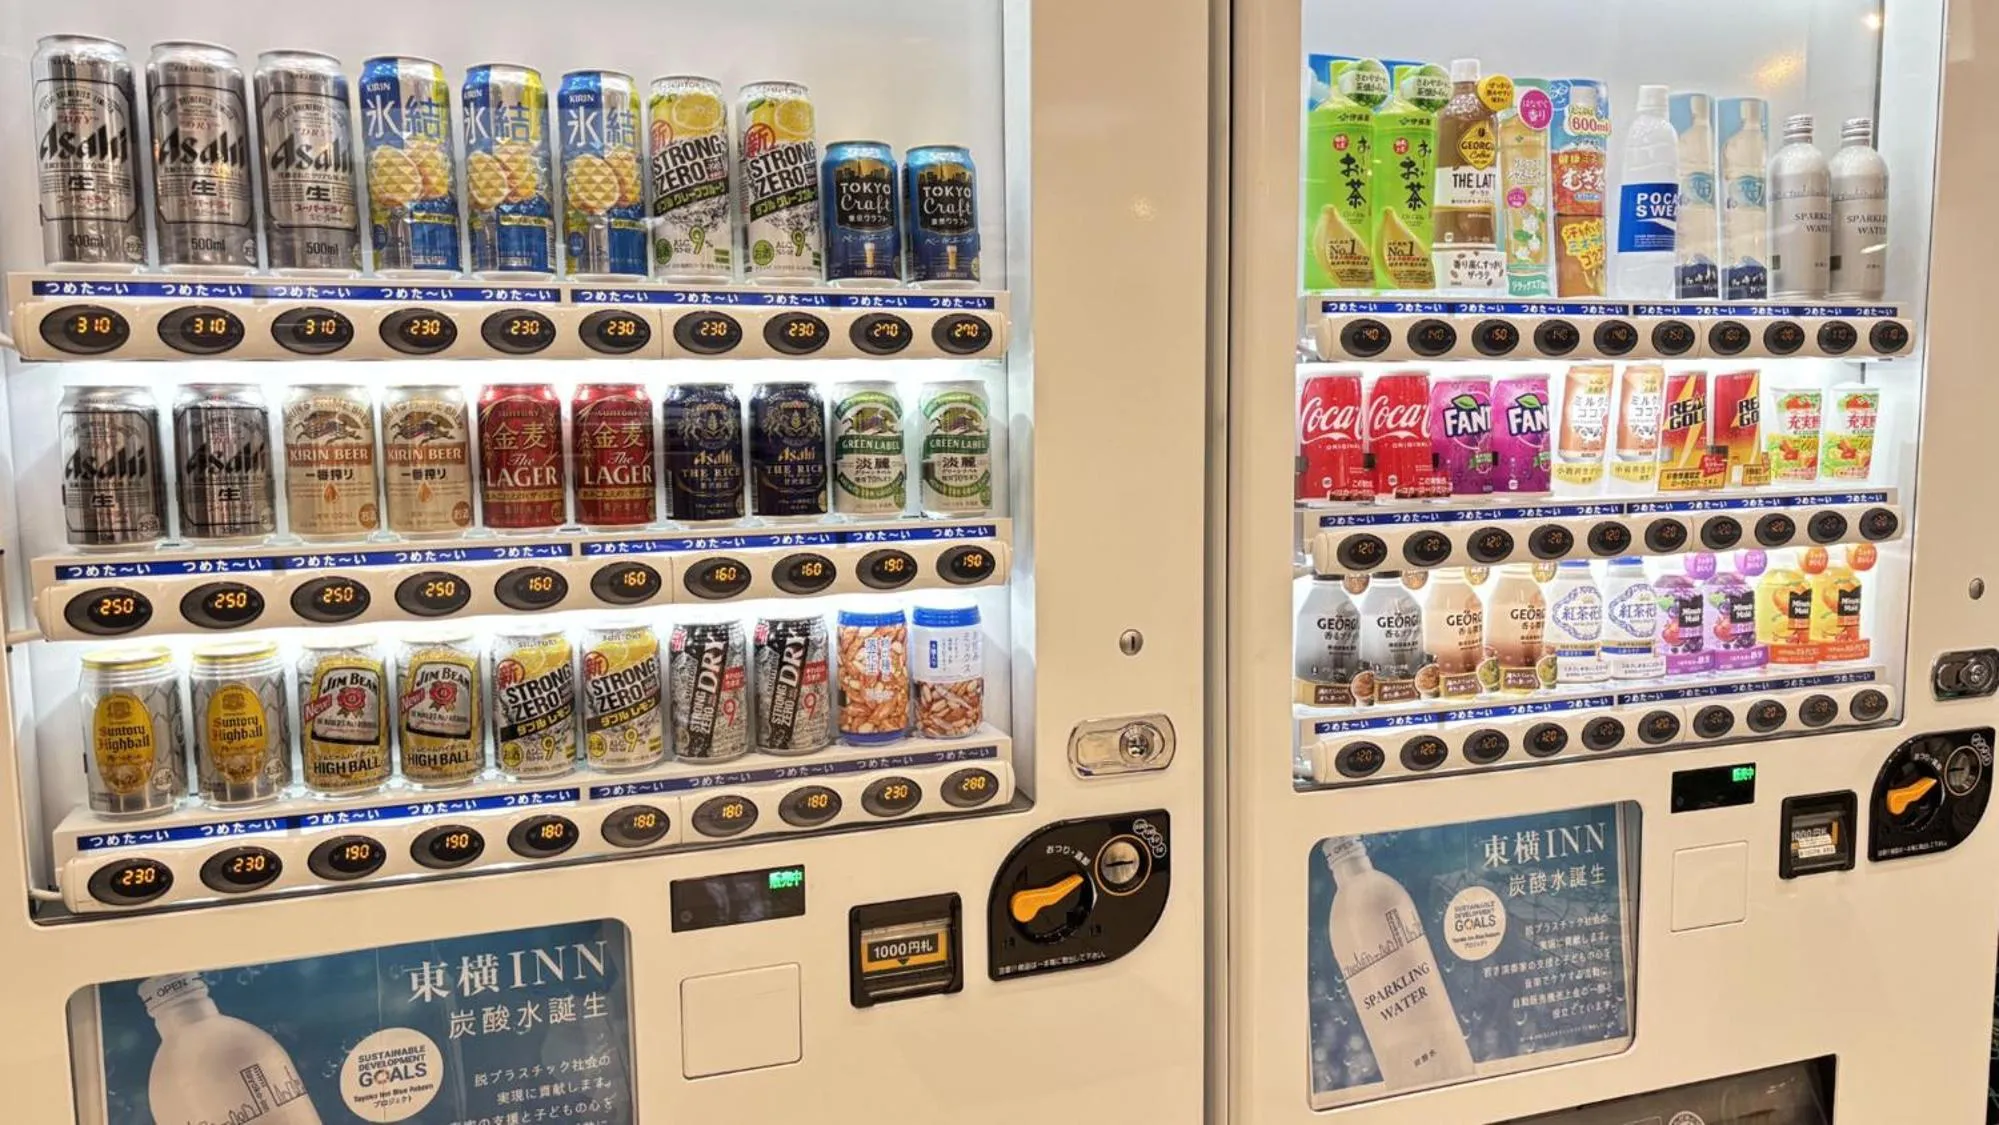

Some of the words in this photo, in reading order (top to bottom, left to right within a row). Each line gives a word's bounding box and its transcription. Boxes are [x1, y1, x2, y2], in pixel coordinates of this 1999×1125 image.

[366, 83, 391, 92] KIRIN
[569, 94, 595, 103] KIRIN
[366, 94, 441, 144] 氷結
[464, 101, 530, 145] 氷結
[1572, 117, 1610, 132] 600ml
[39, 122, 128, 164] Asahi
[159, 128, 244, 169] Asahi
[653, 135, 722, 176] STRONG
[750, 141, 816, 179] STRONG
[68, 175, 95, 191] 生
[655, 160, 706, 195] ZERO
[755, 166, 805, 198] ZERO
[1339, 152, 1367, 209] お茶
[1400, 157, 1427, 211] お茶
[1452, 173, 1474, 189] THE
[191, 179, 217, 196] 生
[306, 185, 331, 201] 生
[840, 182, 891, 194] TOKYO
[923, 186, 971, 198] TOKYO
[841, 194, 892, 213] Craft
[923, 199, 972, 218] Craft
[68, 234, 104, 248] 500ml
[191, 238, 225, 251] 500ml
[306, 241, 339, 255] 500ml
[1388, 240, 1415, 258] No.1
[76, 317, 110, 334] 310
[194, 317, 226, 334] 310
[410, 319, 440, 336] 230
[607, 321, 635, 336] 230
[954, 323, 978, 337] 270
[492, 421, 548, 450] 金麦
[592, 421, 645, 449] 金麦
[65, 444, 145, 480] Asahi
[186, 441, 266, 477] Asahi
[290, 447, 333, 461] KIRIN
[336, 447, 368, 460] BEER
[388, 448, 424, 461] KIRIN
[429, 446, 462, 460] BEER
[507, 452, 535, 466] The
[608, 451, 634, 465] The
[693, 450, 734, 465] Asahi
[778, 446, 816, 463] Asahi
[855, 456, 890, 468] 淡麗
[942, 456, 975, 468] 淡麗
[305, 469, 355, 481] 一番搾り
[401, 468, 447, 480] 一番搾り
[486, 466, 558, 488] LAGER
[584, 465, 653, 485] LAGER
[682, 468, 709, 478] THE
[767, 465, 792, 474] THE
[91, 494, 115, 508] 生
[218, 487, 241, 501] 生
[801, 562, 822, 576] 160
[962, 554, 982, 568] 190
[528, 577, 552, 591] 160
[323, 588, 353, 603] 250
[100, 598, 134, 615] 250
[698, 632, 725, 693] DRY
[780, 628, 806, 687] DRY
[323, 675, 347, 693] JIM
[416, 670, 439, 687] JIM
[506, 663, 571, 704] STRONG
[591, 657, 655, 696] STRONG
[512, 691, 560, 722] ZERO
[597, 684, 642, 714] ZERO
[98, 725, 146, 738] Suntory
[212, 716, 259, 731] Suntory
[98, 734, 149, 752] Highball
[211, 727, 263, 744] Highball
[884, 785, 908, 800] 230
[962, 777, 986, 791] 280
[633, 814, 655, 828] 180
[445, 834, 469, 848] 190
[234, 856, 265, 872] 230
[122, 869, 155, 886] 230
[1509, 863, 1606, 897] 炭酸水誕生
[1455, 916, 1496, 932] GOALS
[873, 940, 932, 959] 1000円札
[157, 979, 187, 998] OPEN
[1364, 962, 1430, 1010] SPARKLING
[1381, 986, 1428, 1021] WATER
[449, 992, 608, 1040] 炭酸水誕生
[358, 1045, 425, 1063] SUSTAINABLE
[358, 1054, 426, 1072] DEVELOPMENT
[359, 1063, 427, 1088] GOALS
[474, 1056, 611, 1088] 脱プラスチック社会の
[497, 1079, 612, 1105] 実現に貢献します。
